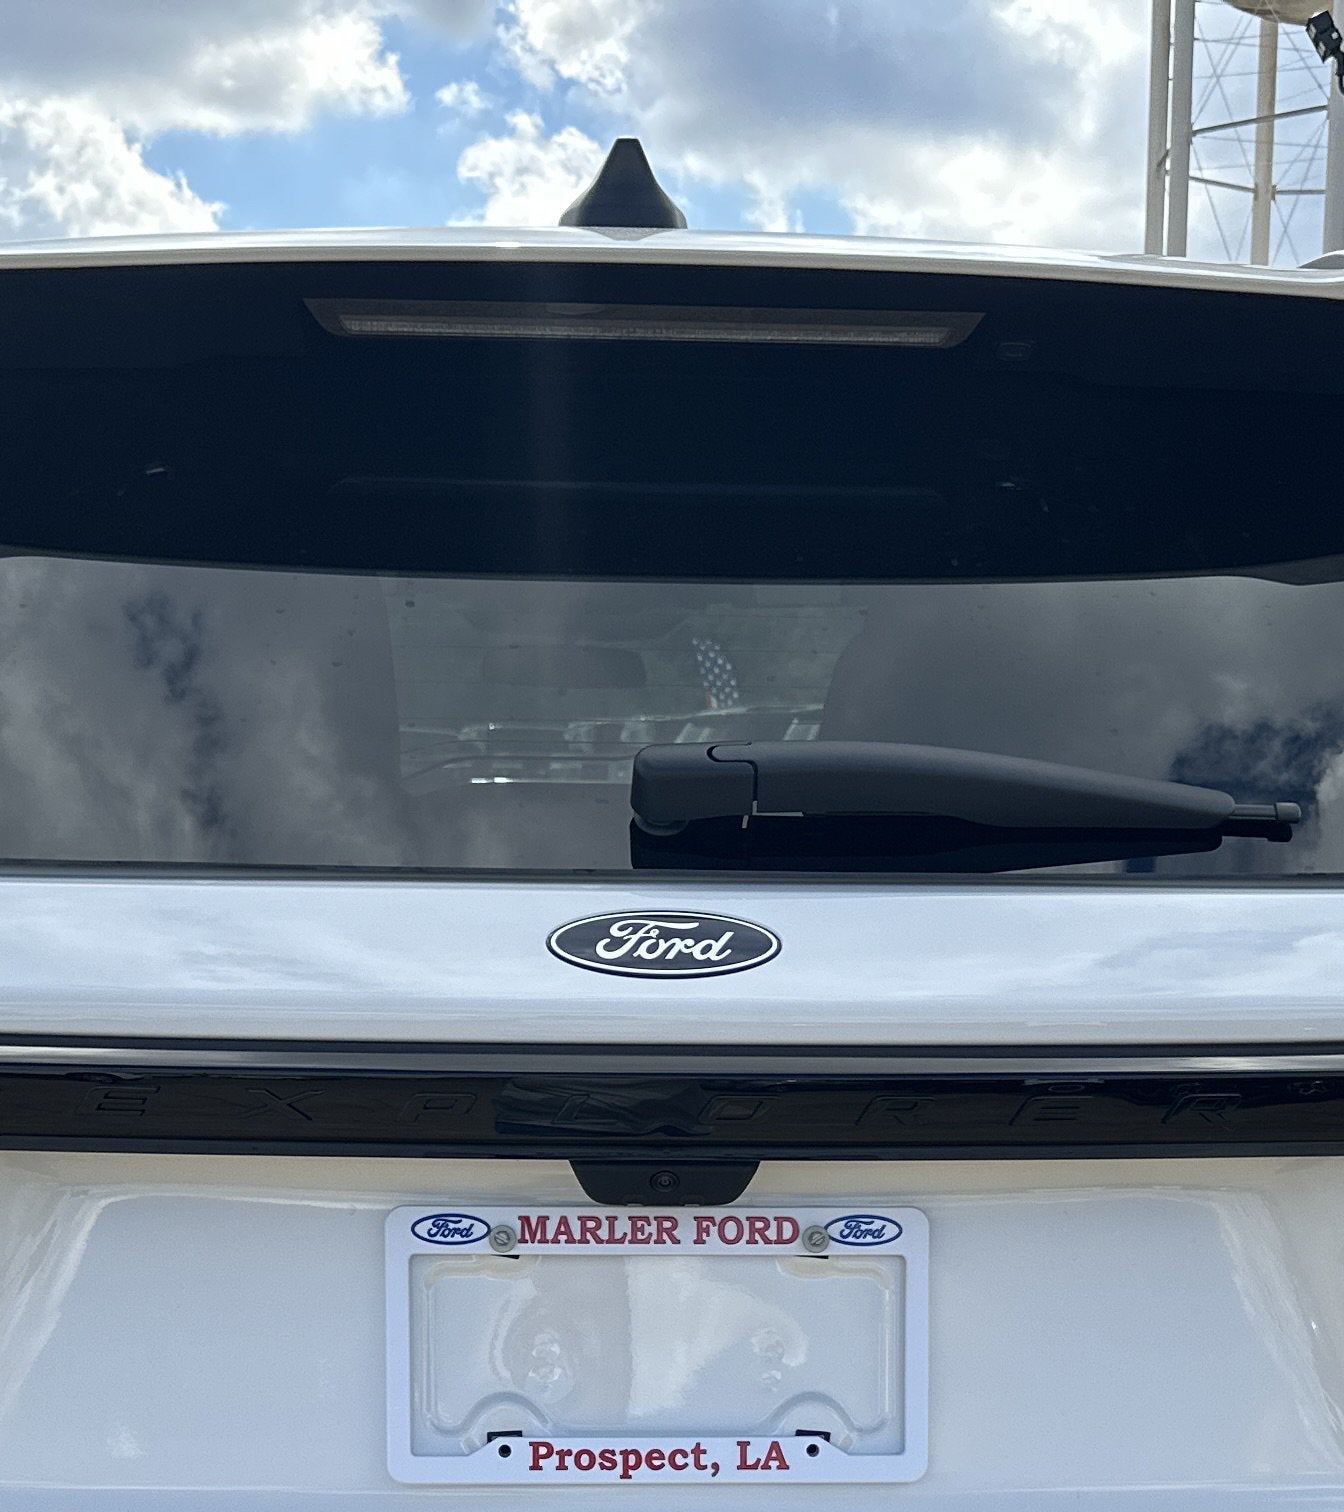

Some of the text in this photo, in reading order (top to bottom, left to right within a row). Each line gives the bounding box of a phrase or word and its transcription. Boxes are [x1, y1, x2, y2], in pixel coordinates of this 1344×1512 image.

[595, 918, 735, 961] Ford
[73, 1084, 1241, 1129] EXPLORER
[427, 1216, 475, 1240] Ford
[517, 1215, 801, 1245] MARLER FORD
[838, 1217, 887, 1241] Ford
[528, 1441, 790, 1479] Prospect, LA
